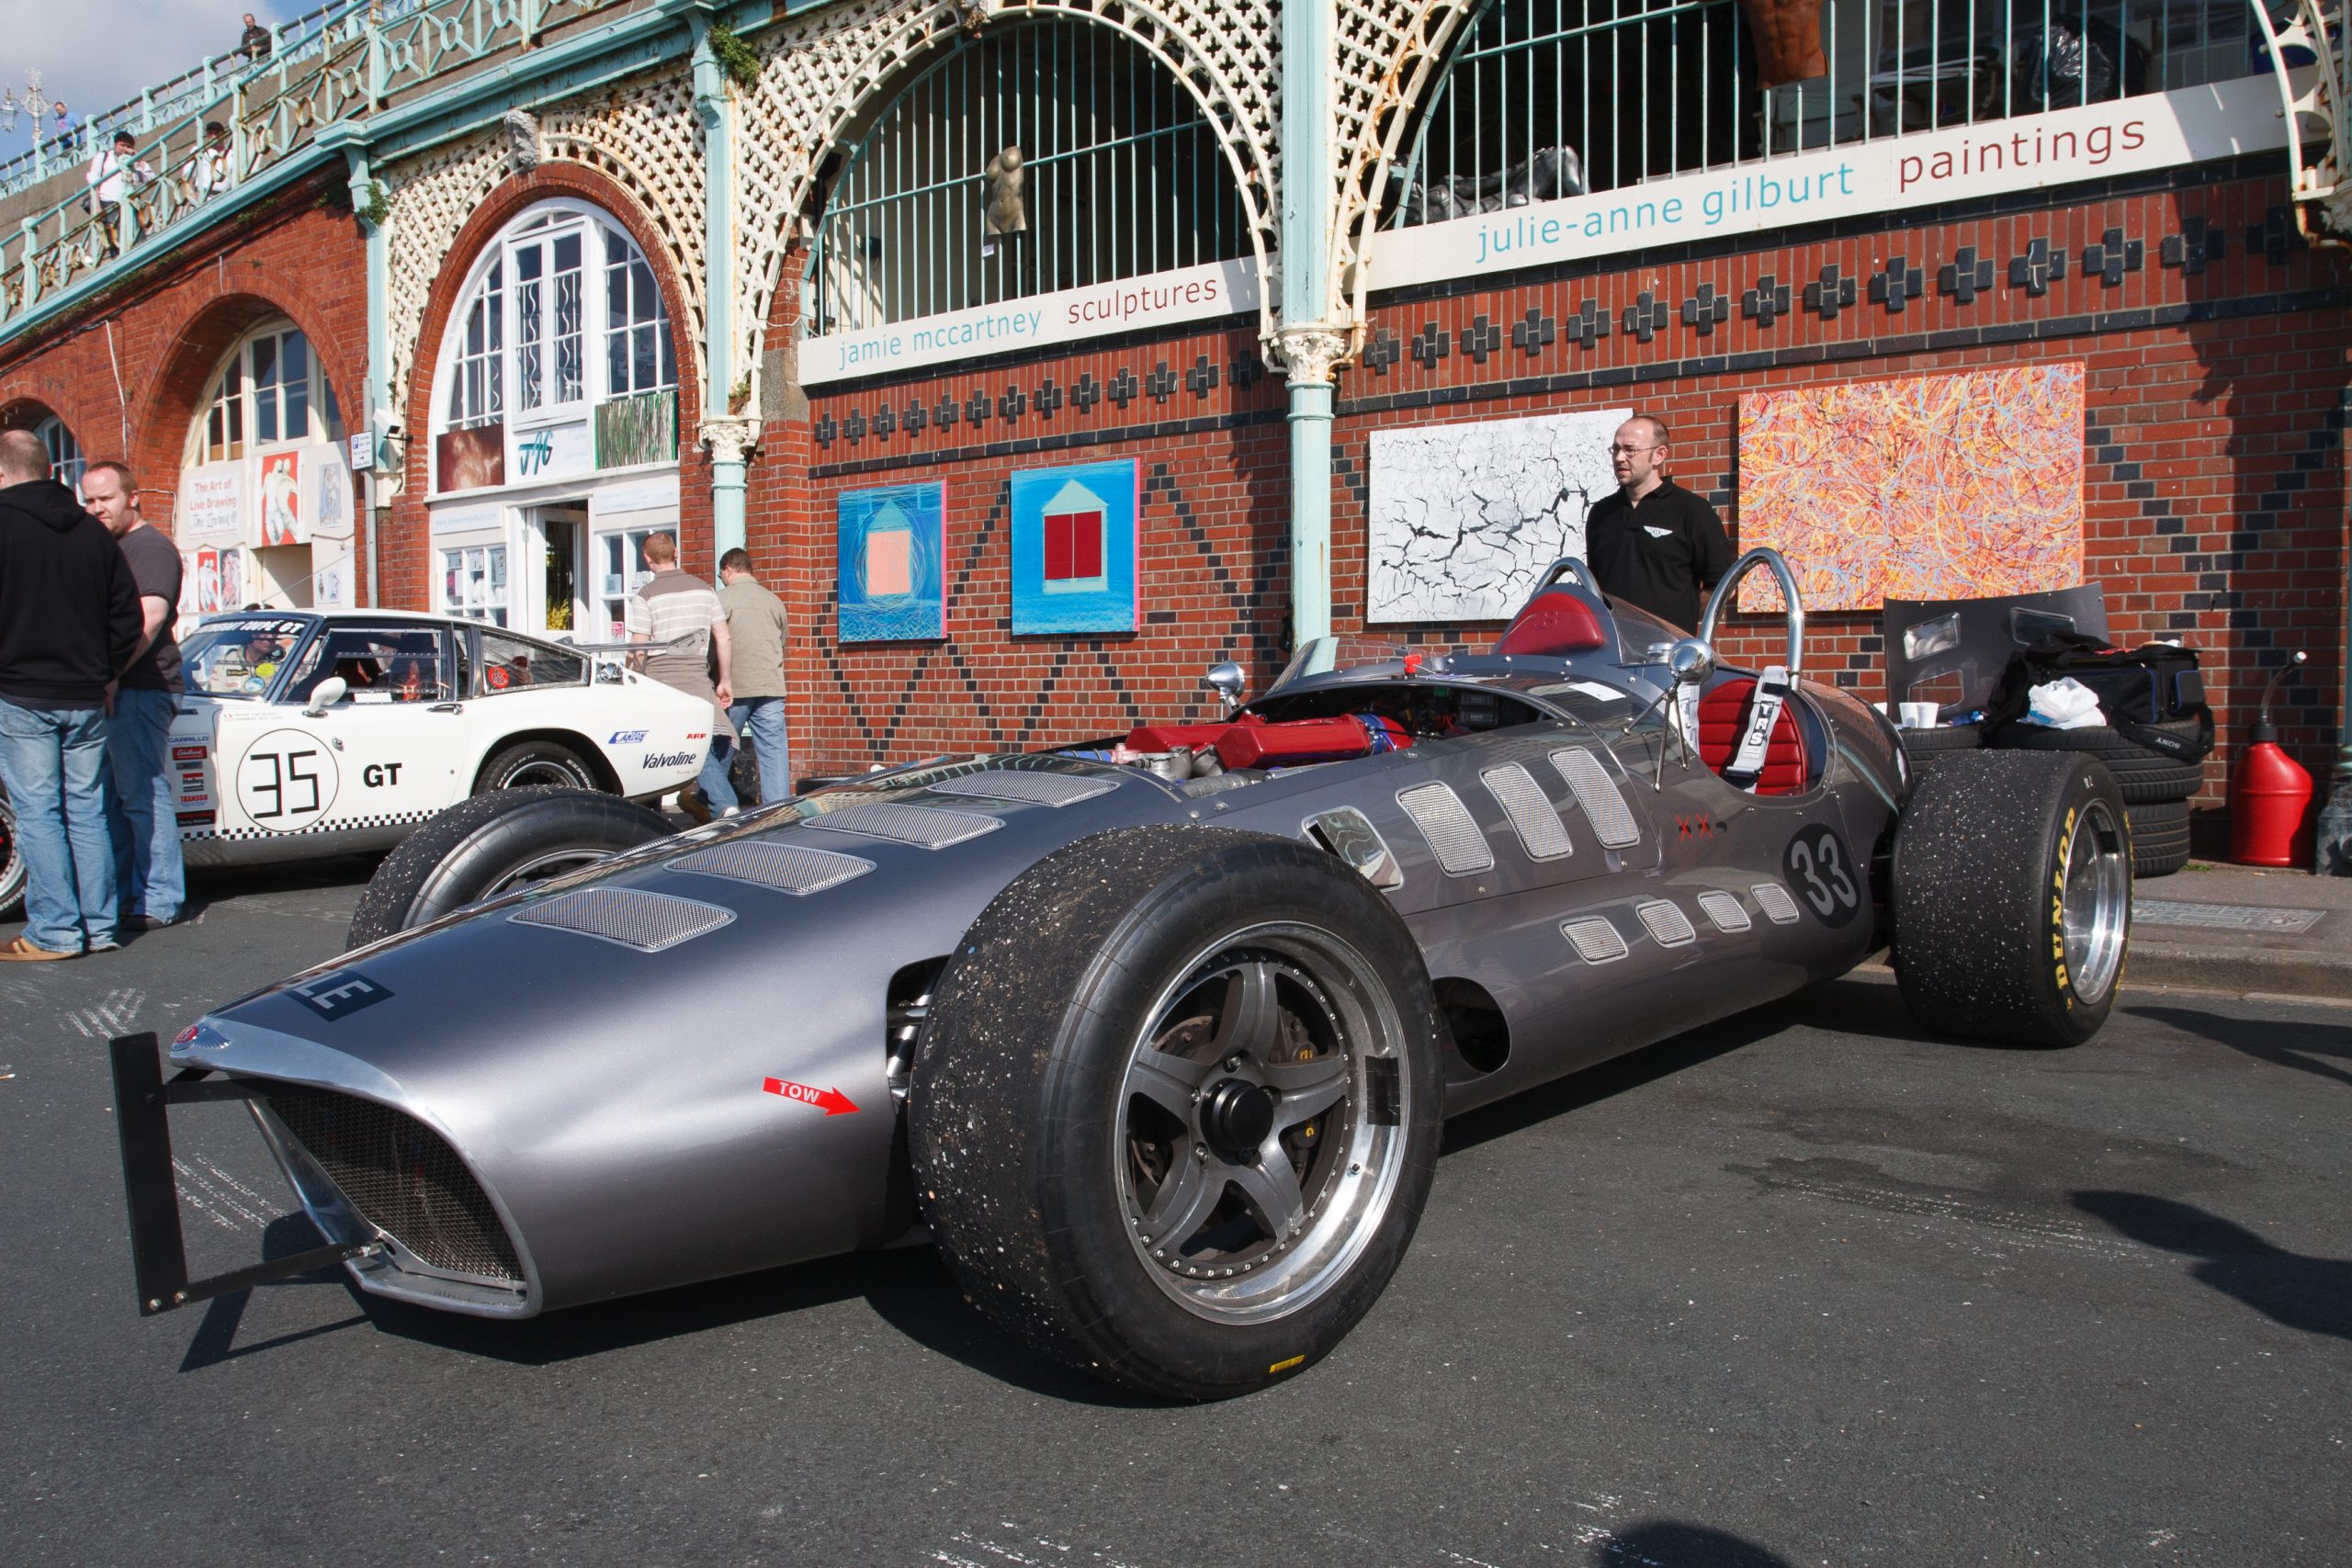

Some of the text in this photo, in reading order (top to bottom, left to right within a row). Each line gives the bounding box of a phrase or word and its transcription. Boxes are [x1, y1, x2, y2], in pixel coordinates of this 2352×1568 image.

[1476, 118, 2145, 265] julie-anne gilburt paintings
[839, 278, 1217, 370] jamie mccartney sculptures
[194, 478, 232, 493] The Art of
[207, 496, 237, 509] Drawing
[278, 622, 305, 634] GT
[1748, 703, 1774, 745] TRS
[2154, 737, 2181, 750] SONY
[642, 751, 696, 770] Valvoline
[182, 777, 204, 785] Holley
[250, 750, 320, 819] 35
[363, 762, 402, 788] GT
[1792, 833, 1857, 916] 33
[779, 1081, 820, 1104] TOW
